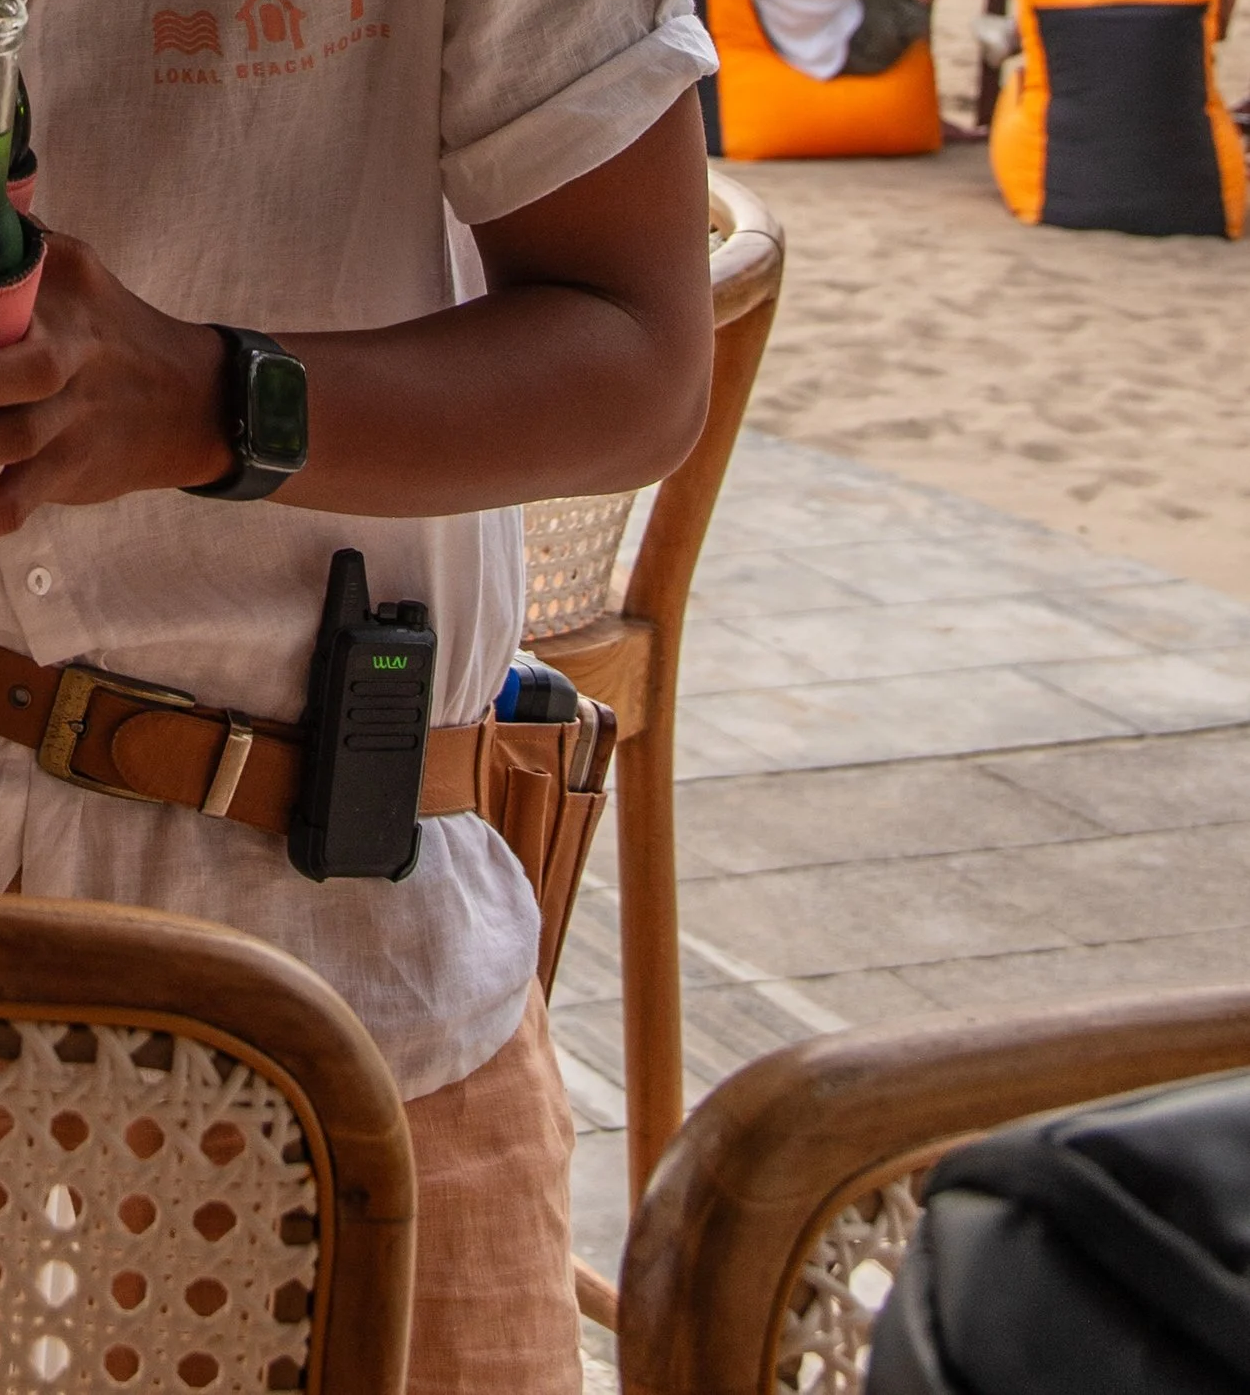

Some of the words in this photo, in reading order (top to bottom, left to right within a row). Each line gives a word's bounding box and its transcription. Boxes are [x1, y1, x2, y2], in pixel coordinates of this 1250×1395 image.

[153, 67, 223, 84] LOKAL
[235, 55, 315, 80] BEACH
[322, 23, 391, 59] HOUSE
